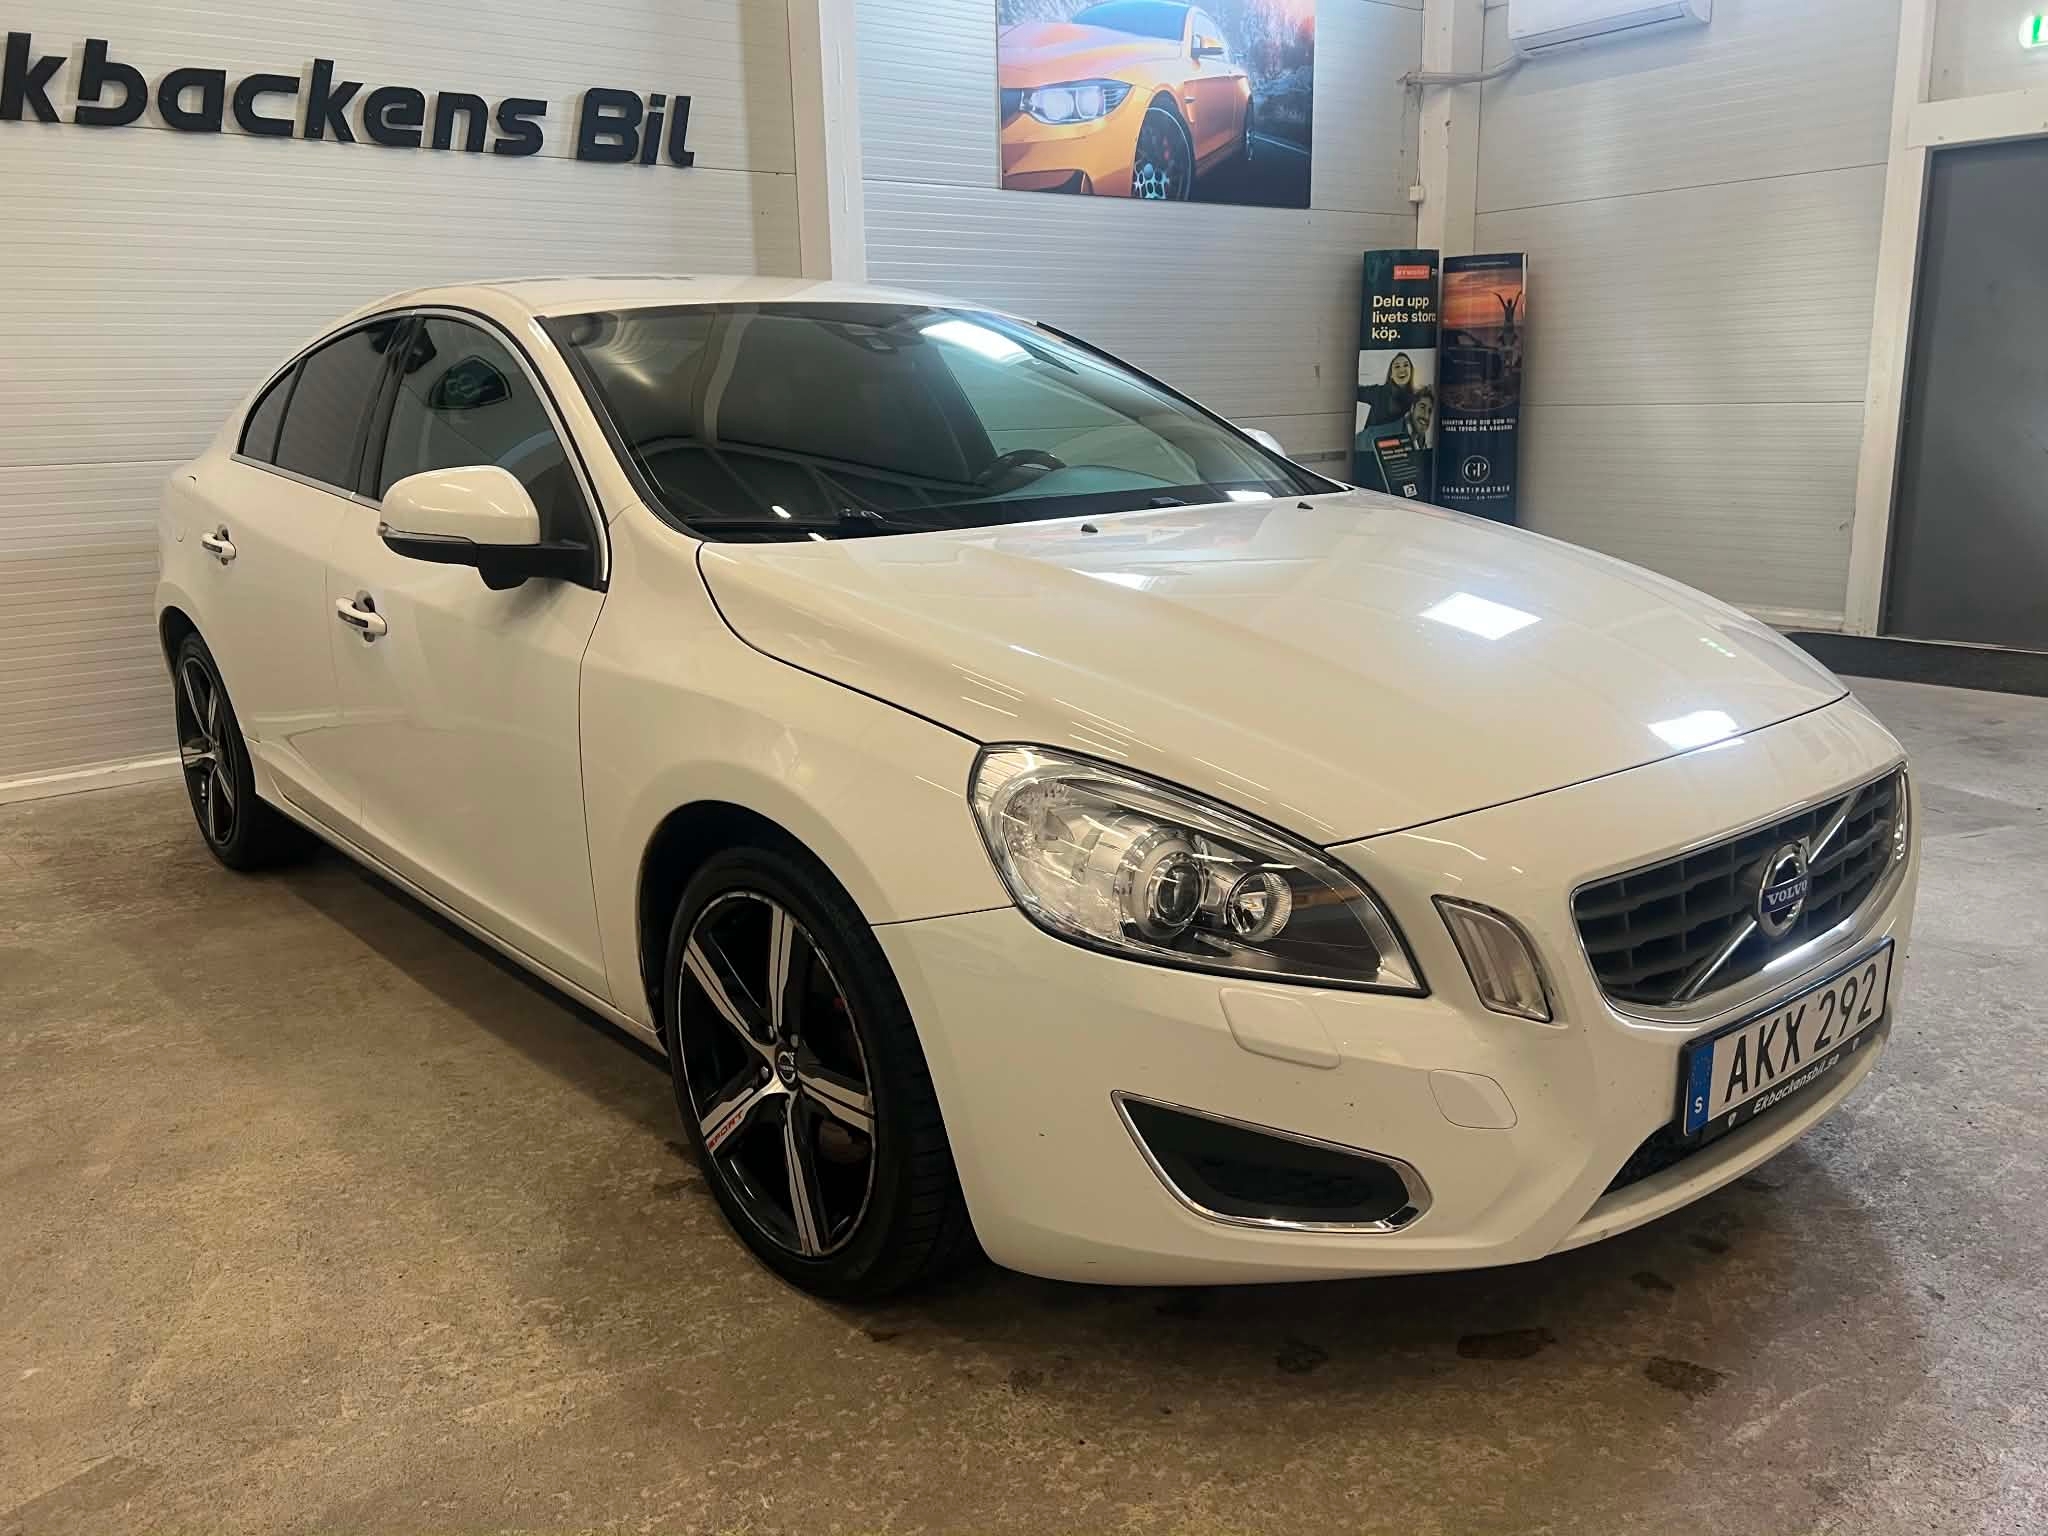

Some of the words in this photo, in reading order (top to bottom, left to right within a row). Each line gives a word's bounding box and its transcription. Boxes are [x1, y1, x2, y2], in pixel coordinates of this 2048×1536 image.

[577, 87, 695, 167] Bil
[1373, 294, 1405, 308] Dela
[1407, 296, 1430, 310] upp
[1372, 310, 1409, 324] livets
[1371, 326, 1401, 342] köp.
[1766, 879, 1808, 906] VOLVO
[1723, 1004, 1807, 1103] AKX
[1813, 963, 1877, 1053] 292
[1693, 1096, 1703, 1114] S
